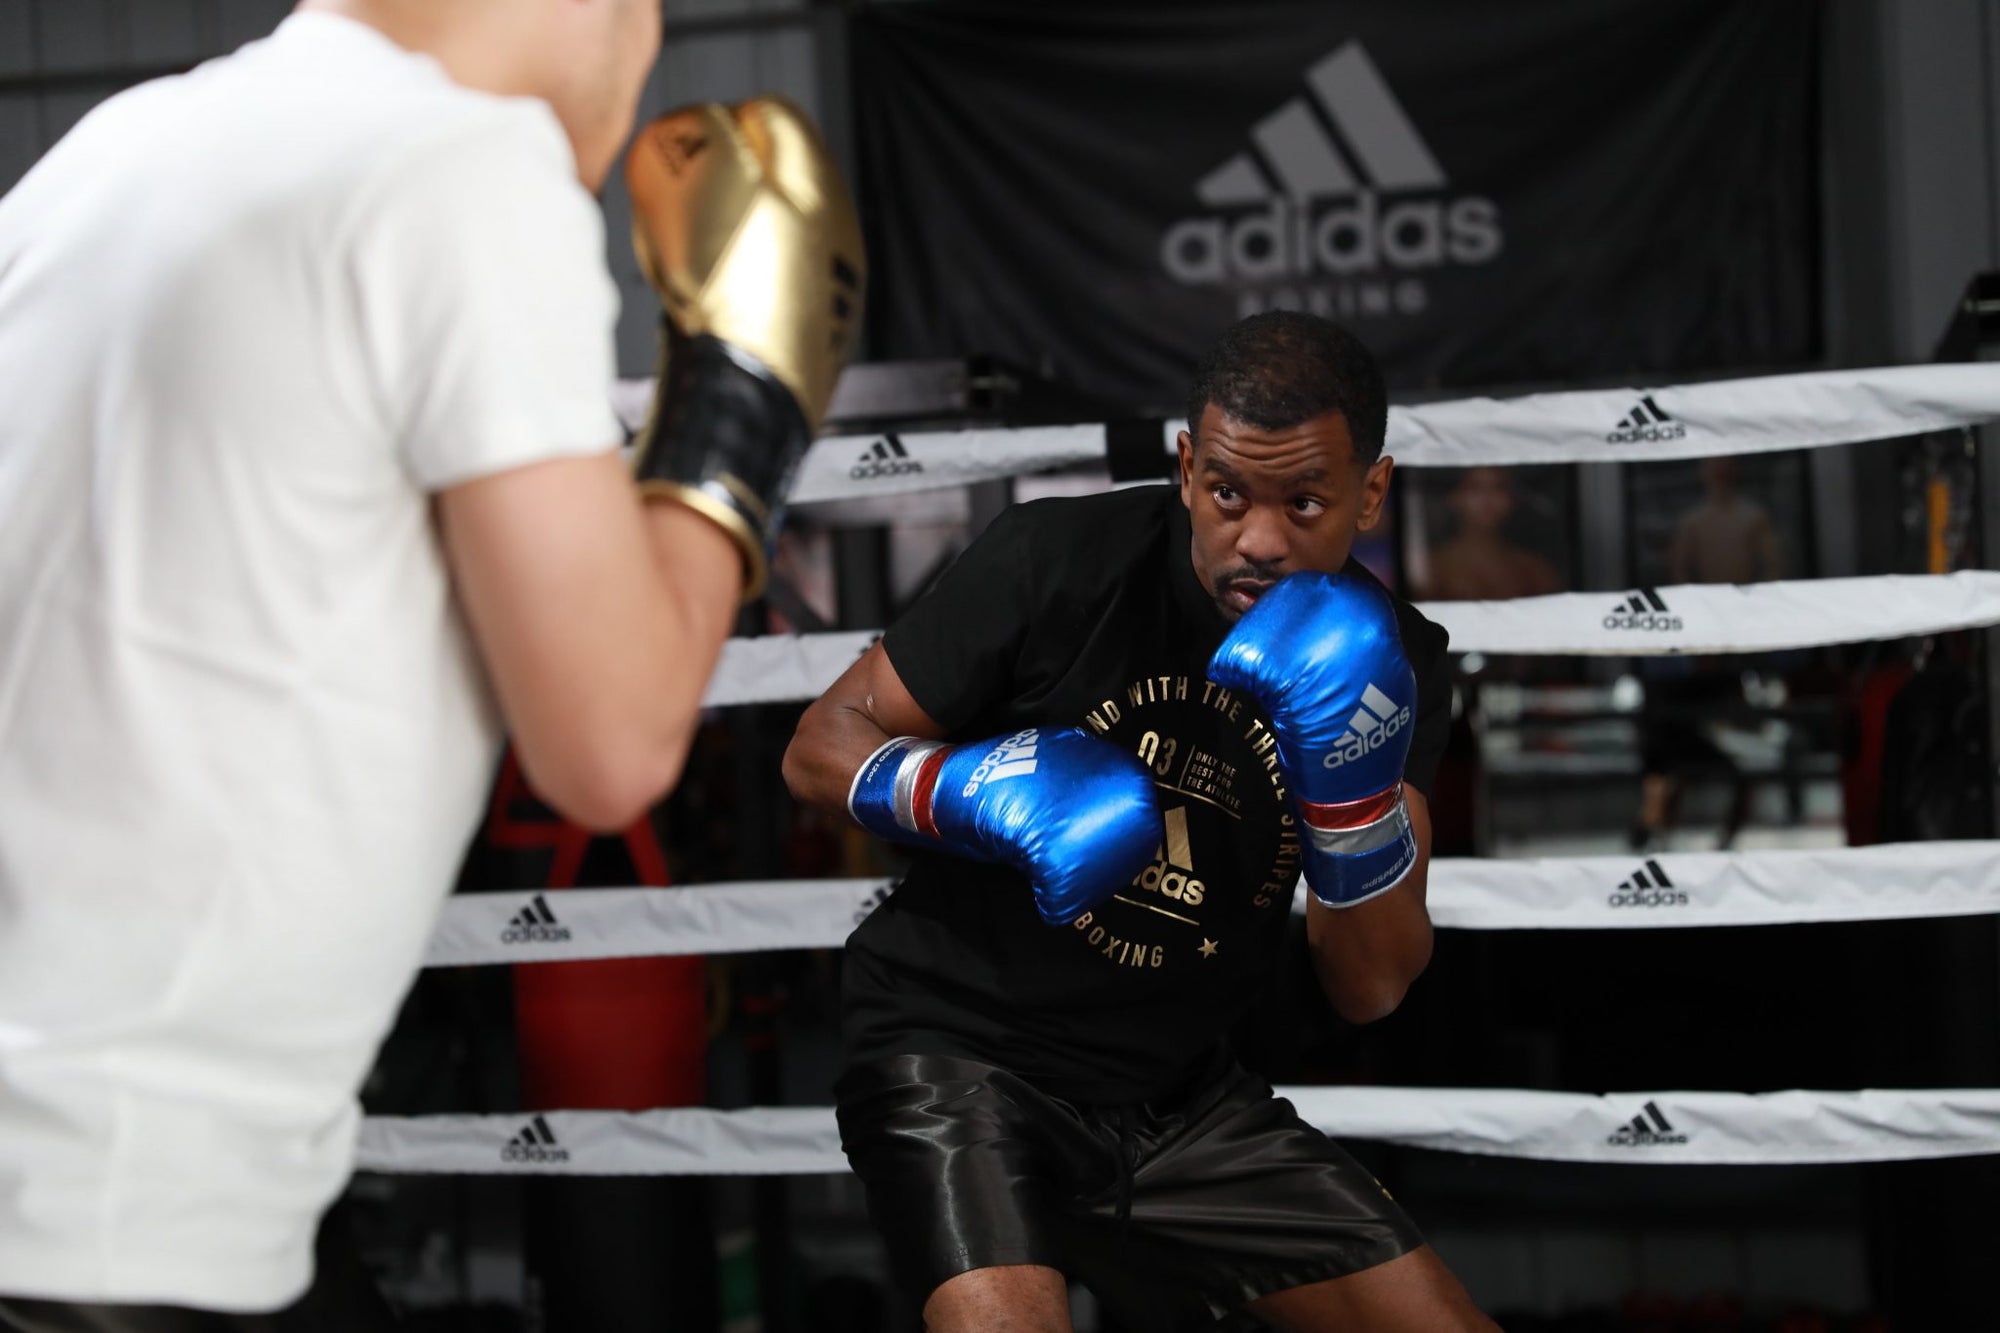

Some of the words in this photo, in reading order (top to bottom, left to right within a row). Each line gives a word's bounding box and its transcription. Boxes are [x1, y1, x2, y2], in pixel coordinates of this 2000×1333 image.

[1161, 190, 1502, 284] adidas
[1606, 421, 1686, 444] adidas
[849, 460, 924, 481] adidas
[1603, 613, 1683, 630] adidas
[1085, 699, 1121, 735] ND
[1127, 676, 1188, 709] WITH
[1202, 680, 1242, 723] THE
[1323, 705, 1411, 769] adidas
[962, 728, 1038, 798] adidas
[1195, 751, 1218, 767] ONLY
[1221, 761, 1237, 777] THE
[1186, 775, 1204, 790] THE
[1191, 763, 1215, 779] BEST
[1215, 774, 1232, 790] FOR
[1132, 861, 1206, 906] das
[1608, 890, 1688, 908] adidas
[500, 926, 571, 945] adidas
[1074, 911, 1164, 968] BOXING
[1607, 1132, 1688, 1148] adidas
[500, 1146, 570, 1163] adidas
